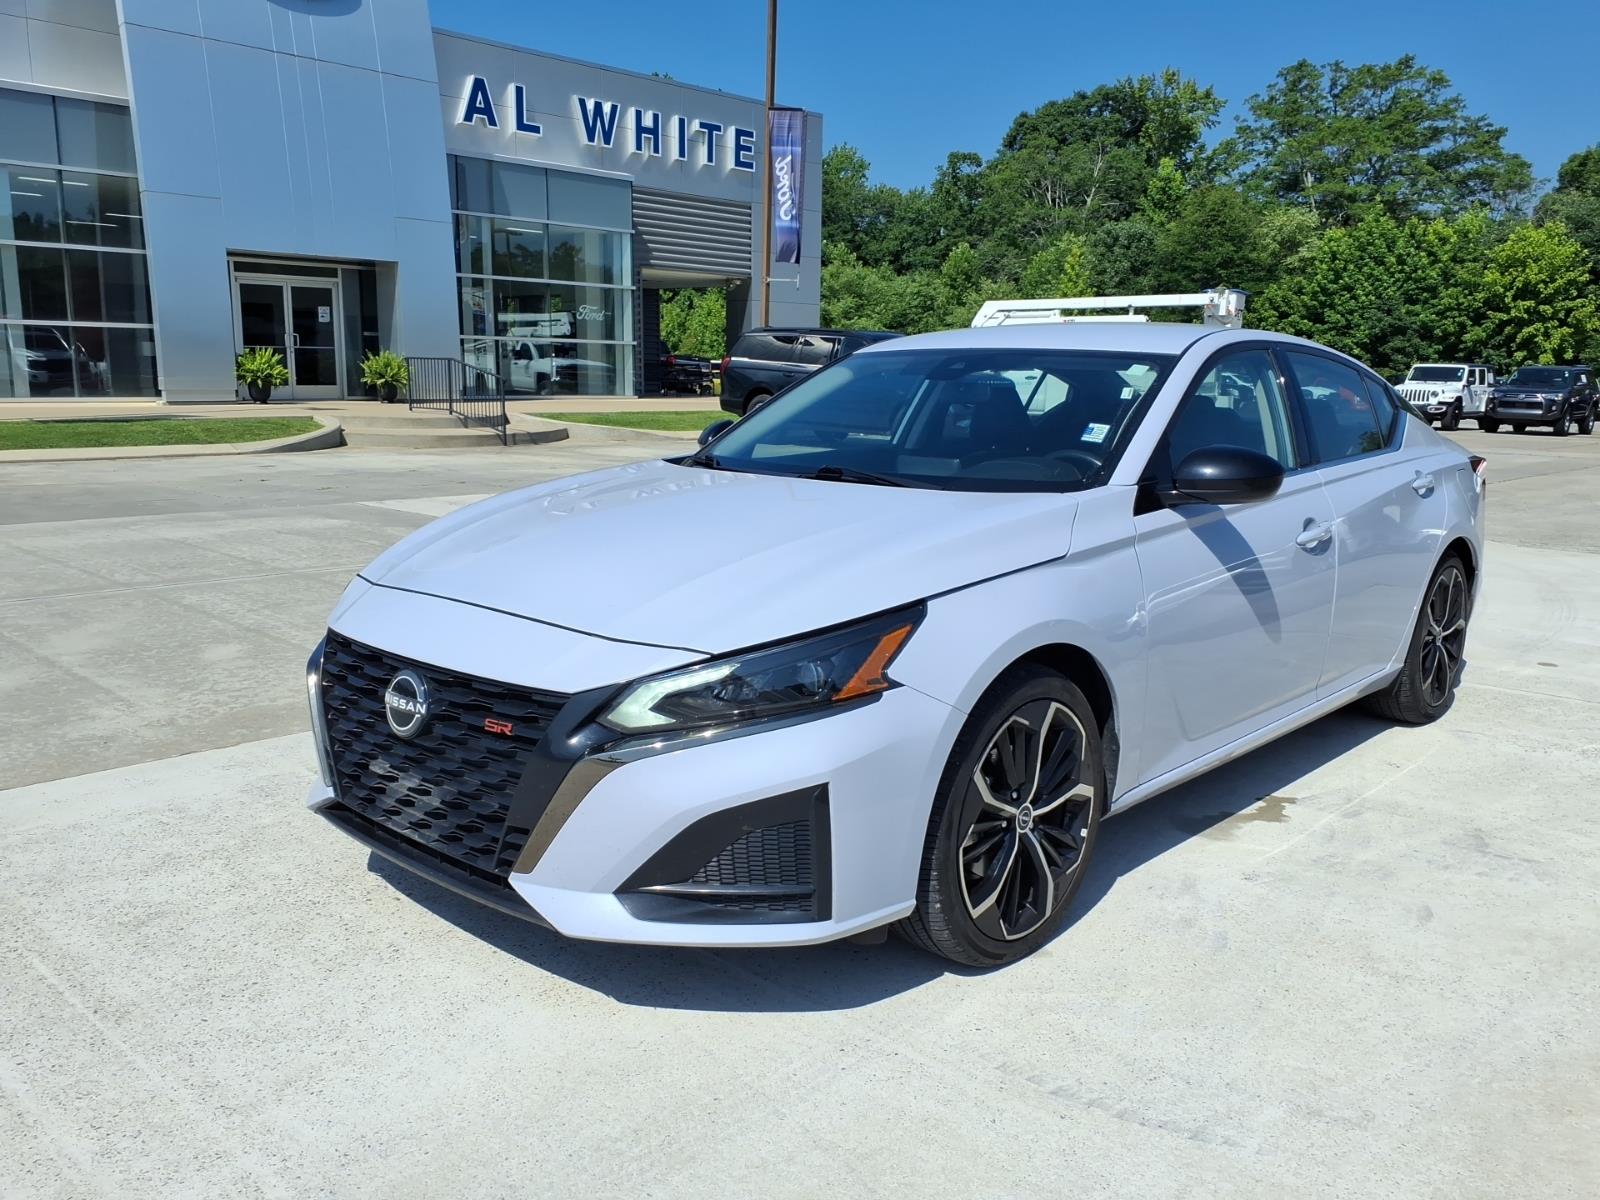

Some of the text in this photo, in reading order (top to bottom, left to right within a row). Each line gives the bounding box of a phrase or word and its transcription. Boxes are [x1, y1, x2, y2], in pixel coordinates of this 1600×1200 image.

[459, 74, 756, 172] AL WHITE
[576, 304, 605, 321] Ford
[385, 689, 426, 714] NISSAN
[484, 718, 513, 736] SR
